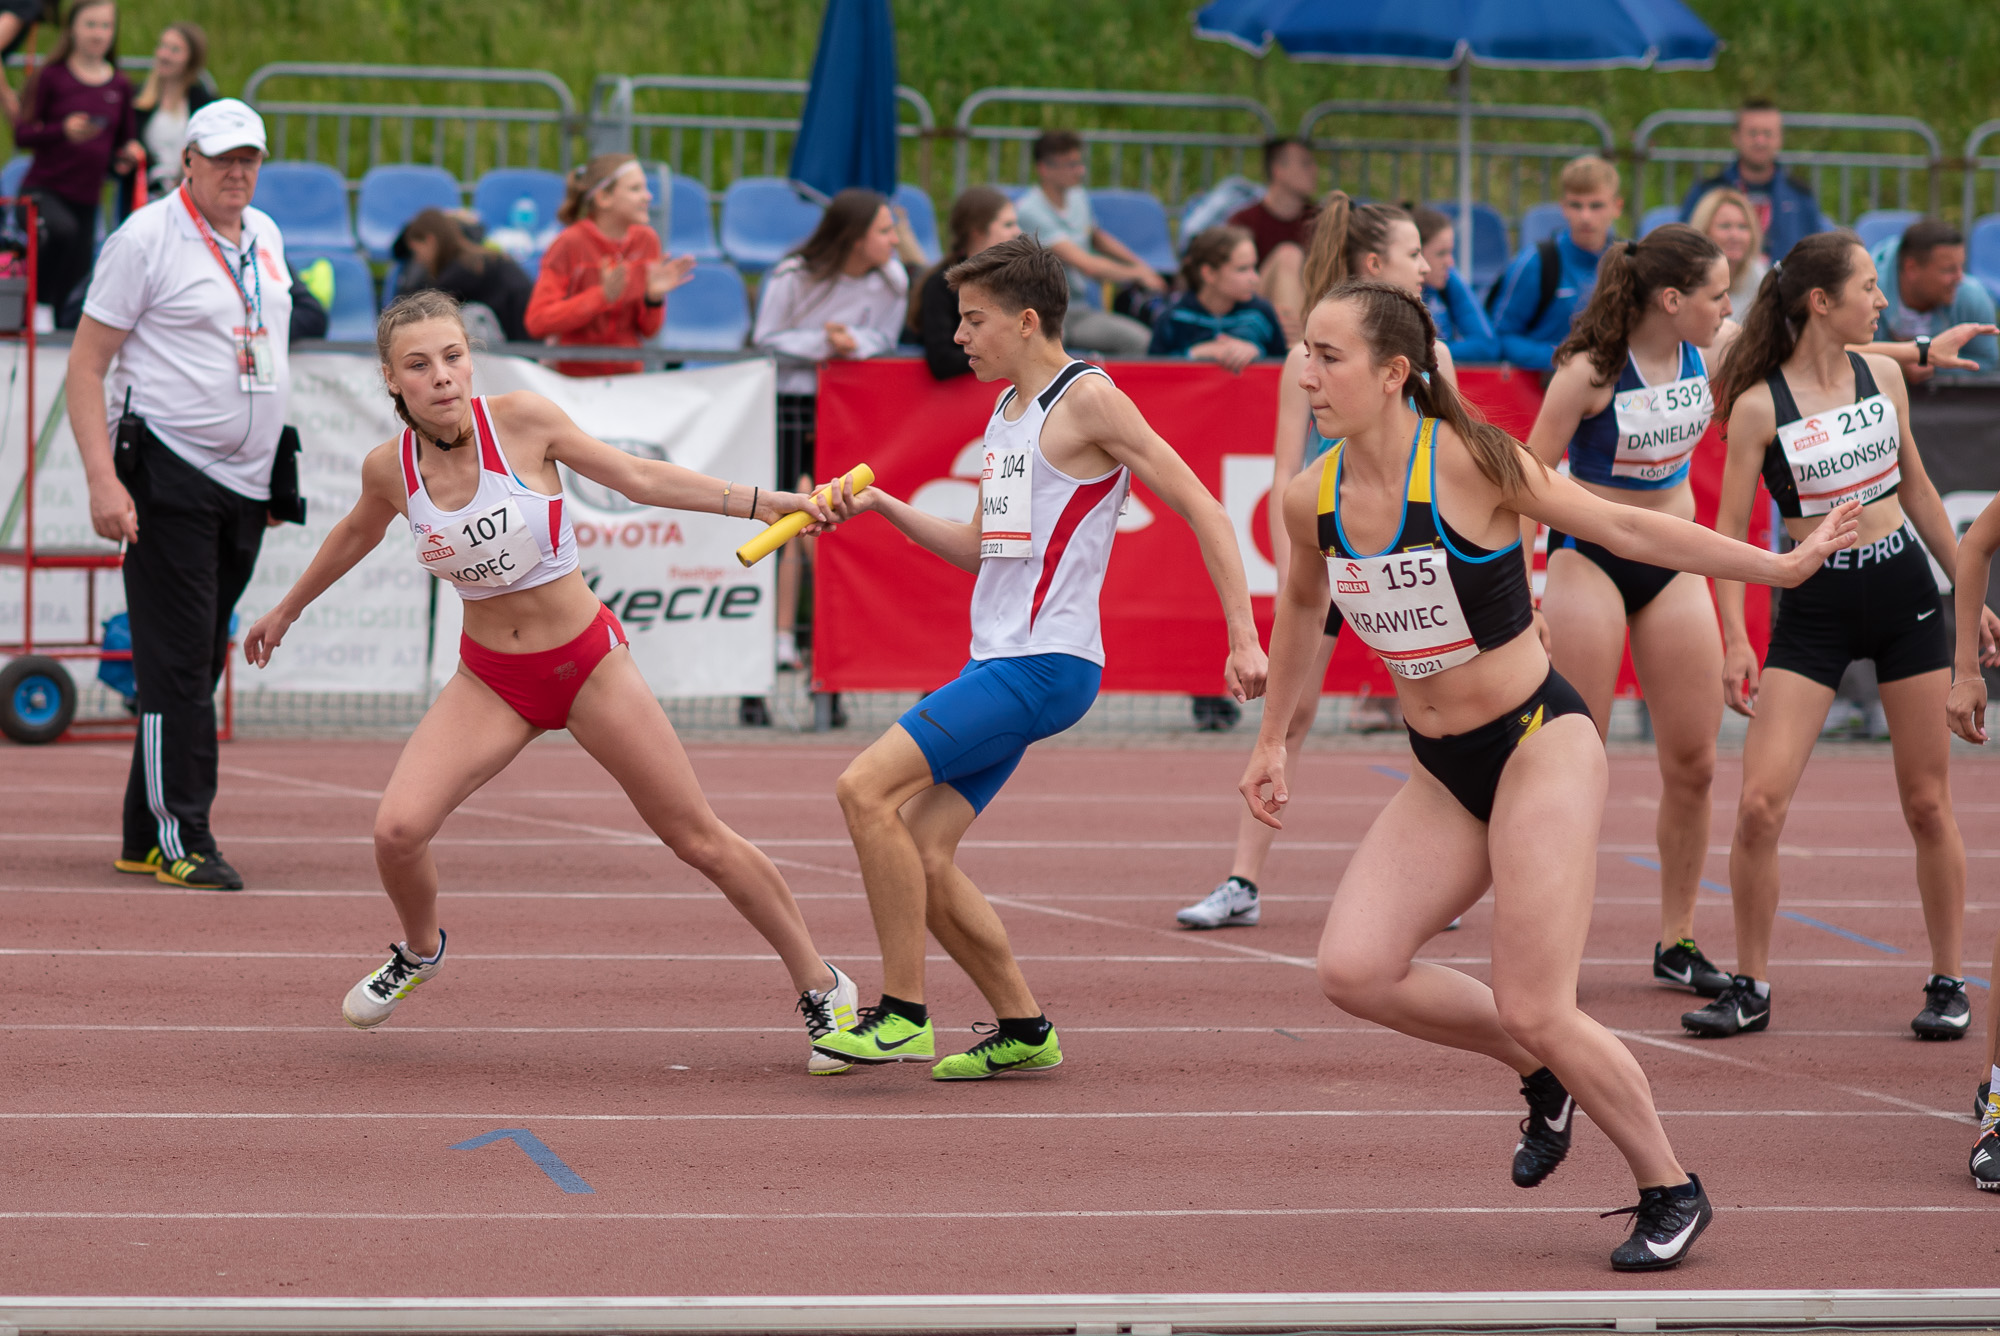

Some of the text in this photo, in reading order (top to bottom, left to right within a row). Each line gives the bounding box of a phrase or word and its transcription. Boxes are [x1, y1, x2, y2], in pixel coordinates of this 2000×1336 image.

[1666, 384, 1702, 410] 539
[1838, 402, 1884, 435] 219
[1627, 420, 1706, 450] DANIELAK
[1795, 433, 1828, 450] ORLEN
[1001, 454, 1025, 479] 104
[1799, 437, 1897, 482] JABŁOŃSKA
[982, 496, 1008, 515] ANAS
[1862, 483, 1882, 500] 2021
[462, 507, 507, 548] 107
[575, 521, 684, 549] OYOTA
[1858, 531, 1904, 568] PRO
[451, 549, 516, 582] KOPEĆ
[1382, 558, 1436, 590] 155
[582, 566, 762, 631] kęcie
[1338, 582, 1368, 592] ORLEN
[1350, 605, 1448, 633] KRAWIEC
[1411, 659, 1443, 676] 2021
